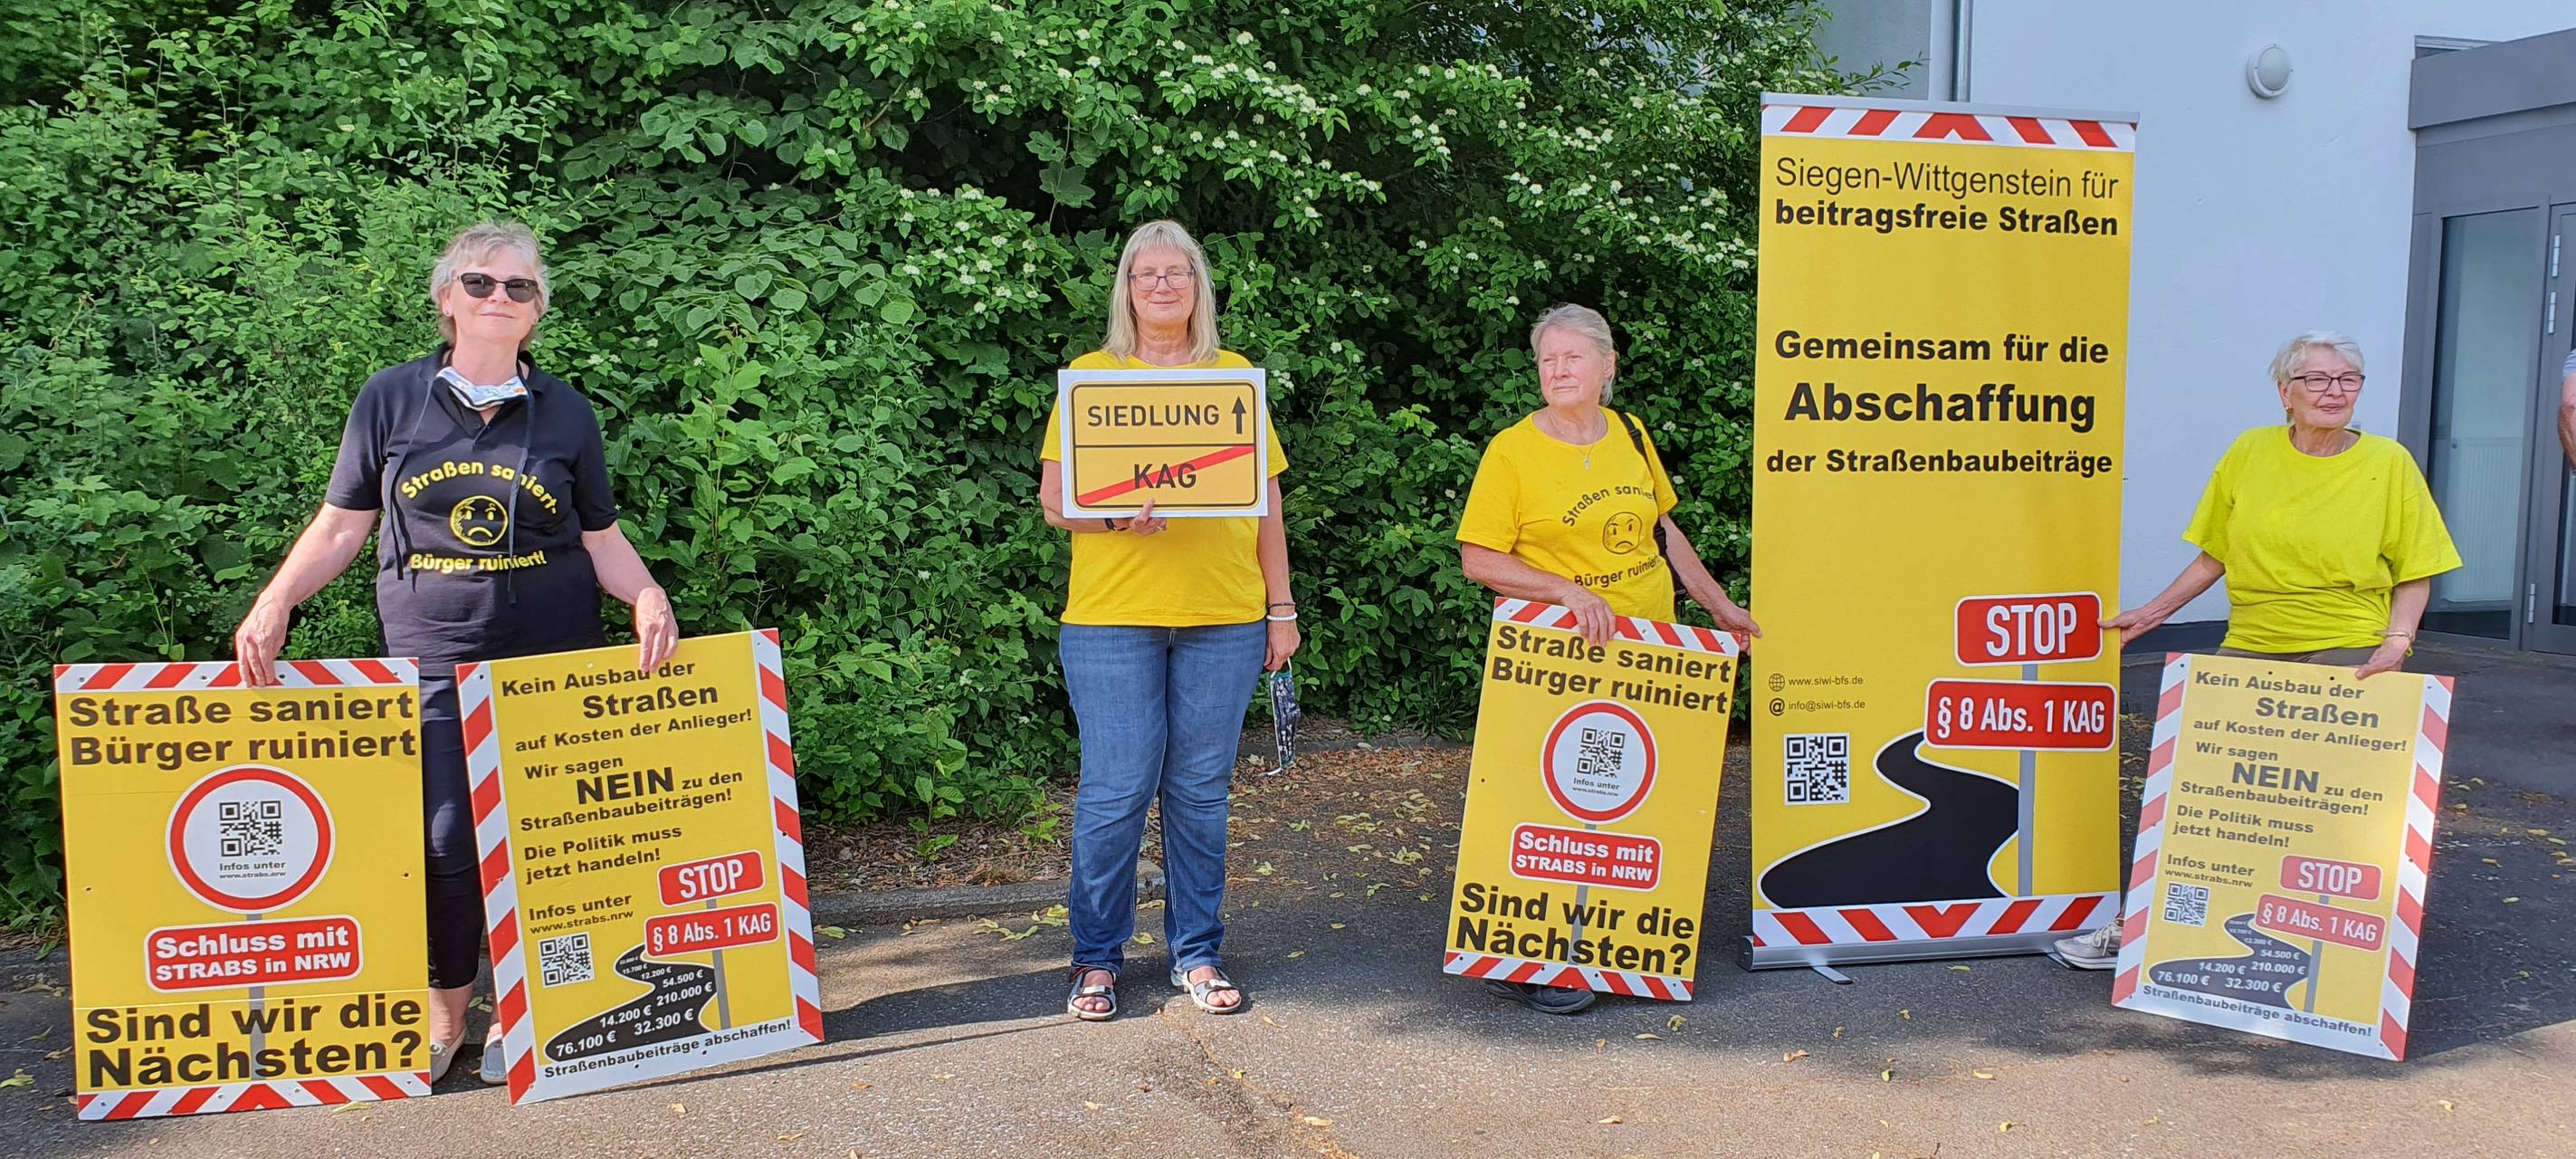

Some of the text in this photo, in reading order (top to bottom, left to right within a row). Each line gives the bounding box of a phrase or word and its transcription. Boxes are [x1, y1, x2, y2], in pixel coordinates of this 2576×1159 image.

[1776, 157, 2119, 199] Siegen-Wittgenstein für
[1775, 199, 2118, 235] beitragsfreie Straßen
[1775, 330, 2109, 363] Gemeinsam für die
[1088, 405, 1219, 426] SIEDLUNG
[1784, 382, 2095, 433] Abschaffung
[1134, 463, 1197, 489] KAG
[1767, 449, 2113, 478] der Straßenbaubeiträge
[401, 461, 484, 499] Straßen
[1562, 485, 1654, 527] Straßen sanie
[411, 551, 547, 573] Bürger ruiniert!
[1574, 556, 1660, 588] Bürger ruinier
[1986, 603, 2077, 656] STOP
[1496, 626, 1731, 684] Straße saniert
[501, 661, 695, 696] Kein Ausbau der
[1491, 656, 1727, 714] Bürger ruiniert
[1789, 675, 1864, 685] www.siwi-bfs.de
[2195, 671, 2364, 699] Kein Ausbau der
[70, 693, 414, 725] Straße saniert
[582, 685, 719, 719] Straßen
[1789, 700, 1865, 712] info@siwi-bfs.de
[1938, 696, 2105, 739] § 8 Abs. 1 KAG
[2256, 697, 2380, 728] Straßen
[515, 709, 752, 752] auf Kosten der Anlieger!
[2193, 718, 2407, 752] auf Kosten der Anlieger!
[71, 730, 416, 771] Bürger ruiniert
[2196, 742, 2278, 762] Wir sagen
[524, 755, 624, 779] Wir sagen
[1574, 778, 1594, 786] Infos
[2231, 762, 2383, 801] NEIN zu den
[576, 767, 743, 805] NEIN zu den
[2180, 781, 2369, 816] Straßenbaubeiträgen!
[520, 789, 732, 831] Straßenbaubeiträgen!
[2177, 805, 2314, 834] Die Politik muss
[524, 827, 682, 860] Die Politik muss
[1518, 831, 1654, 863] Schluss mit
[2172, 821, 2289, 848] jetzt handeln!
[220, 863, 250, 871] Infos
[525, 848, 661, 885] jetzt handeln!
[679, 859, 744, 898] STOP
[1515, 855, 1653, 881] STRABS in NRW
[2165, 869, 2253, 887] www.strabs.nrw
[2168, 855, 2255, 876] Infos unter
[2297, 861, 2361, 895] STOP
[530, 895, 632, 920] Infos unter
[530, 911, 634, 934] www.strabs.nrw
[1461, 882, 1694, 939] Sind wir die
[2263, 903, 2377, 942] § 8 Abs. 1 KAG
[156, 926, 348, 959] Schluss mit
[652, 913, 772, 953] § 8 Abs. 1 KAG
[1455, 916, 1692, 976] Nächsten?
[156, 953, 350, 982] STRABS in NRW
[2199, 961, 2246, 975] 14.200 €
[2251, 962, 2306, 974] 210.000 €
[2260, 950, 2291, 959] 54.500
[641, 969, 664, 980] 12.200
[663, 970, 703, 988] 54.500 €
[2157, 970, 2209, 986] 76.100 €
[2224, 977, 2282, 992] 32.300 €
[656, 982, 712, 1006] 210.000 €
[87, 994, 422, 1043] Sind wir die
[599, 1006, 653, 1029] 14.200 €
[634, 1009, 694, 1036] 32.300 €
[2143, 985, 2371, 1037] Straßenbaubeiträge abschaffen!
[91, 1030, 423, 1087] Nächsten?
[544, 1020, 791, 1078] Straßenbaubeiträge abschaffen!
[556, 1030, 616, 1057] 76.100 €
